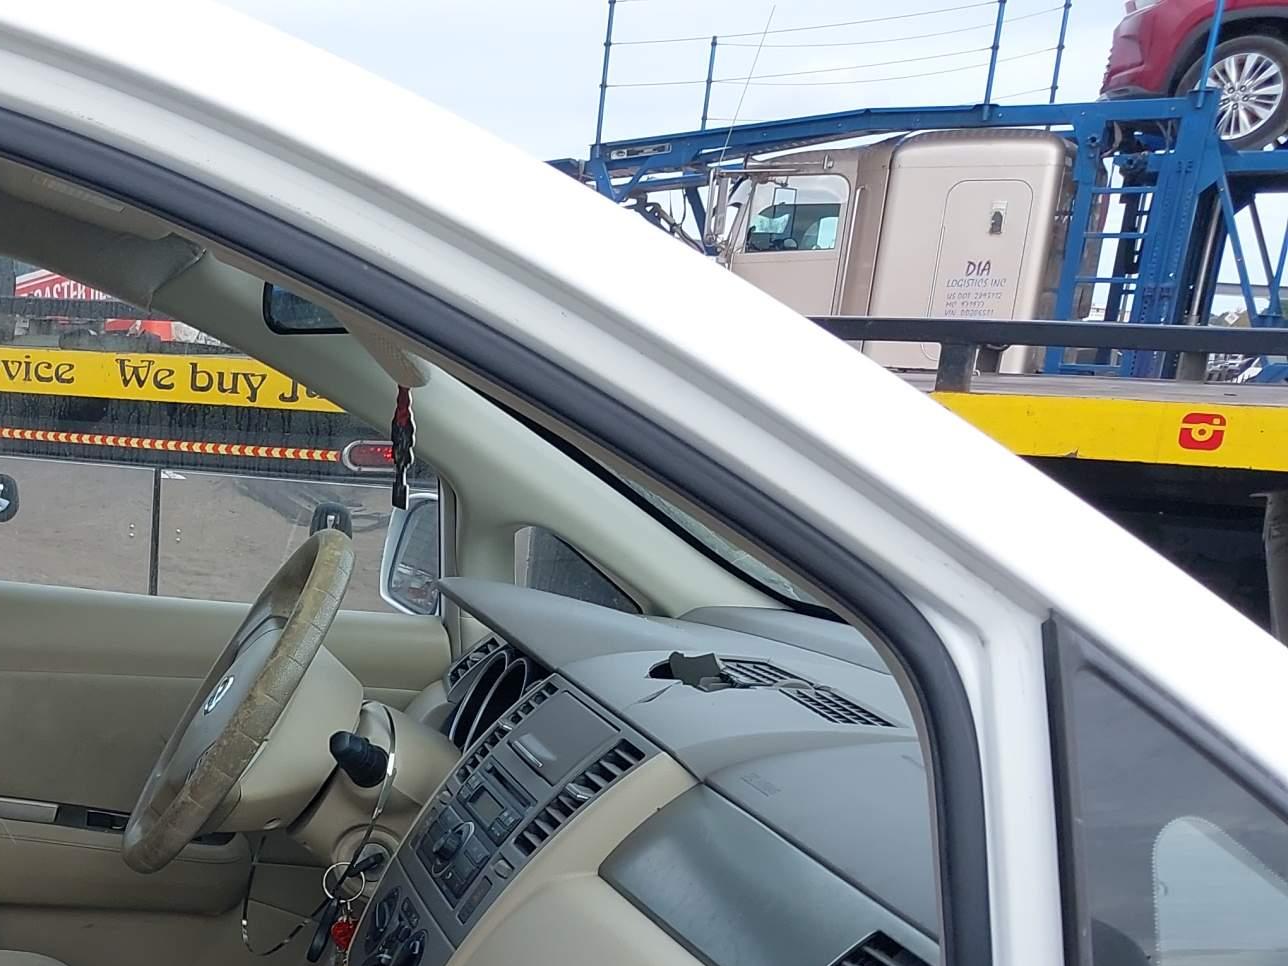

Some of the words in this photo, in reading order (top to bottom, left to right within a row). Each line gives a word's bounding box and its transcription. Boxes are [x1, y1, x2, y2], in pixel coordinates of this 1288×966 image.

[965, 260, 991, 277] DIA
[946, 278, 989, 289] LOGISTICS
[115, 358, 175, 389] We
[190, 362, 268, 402] buy
